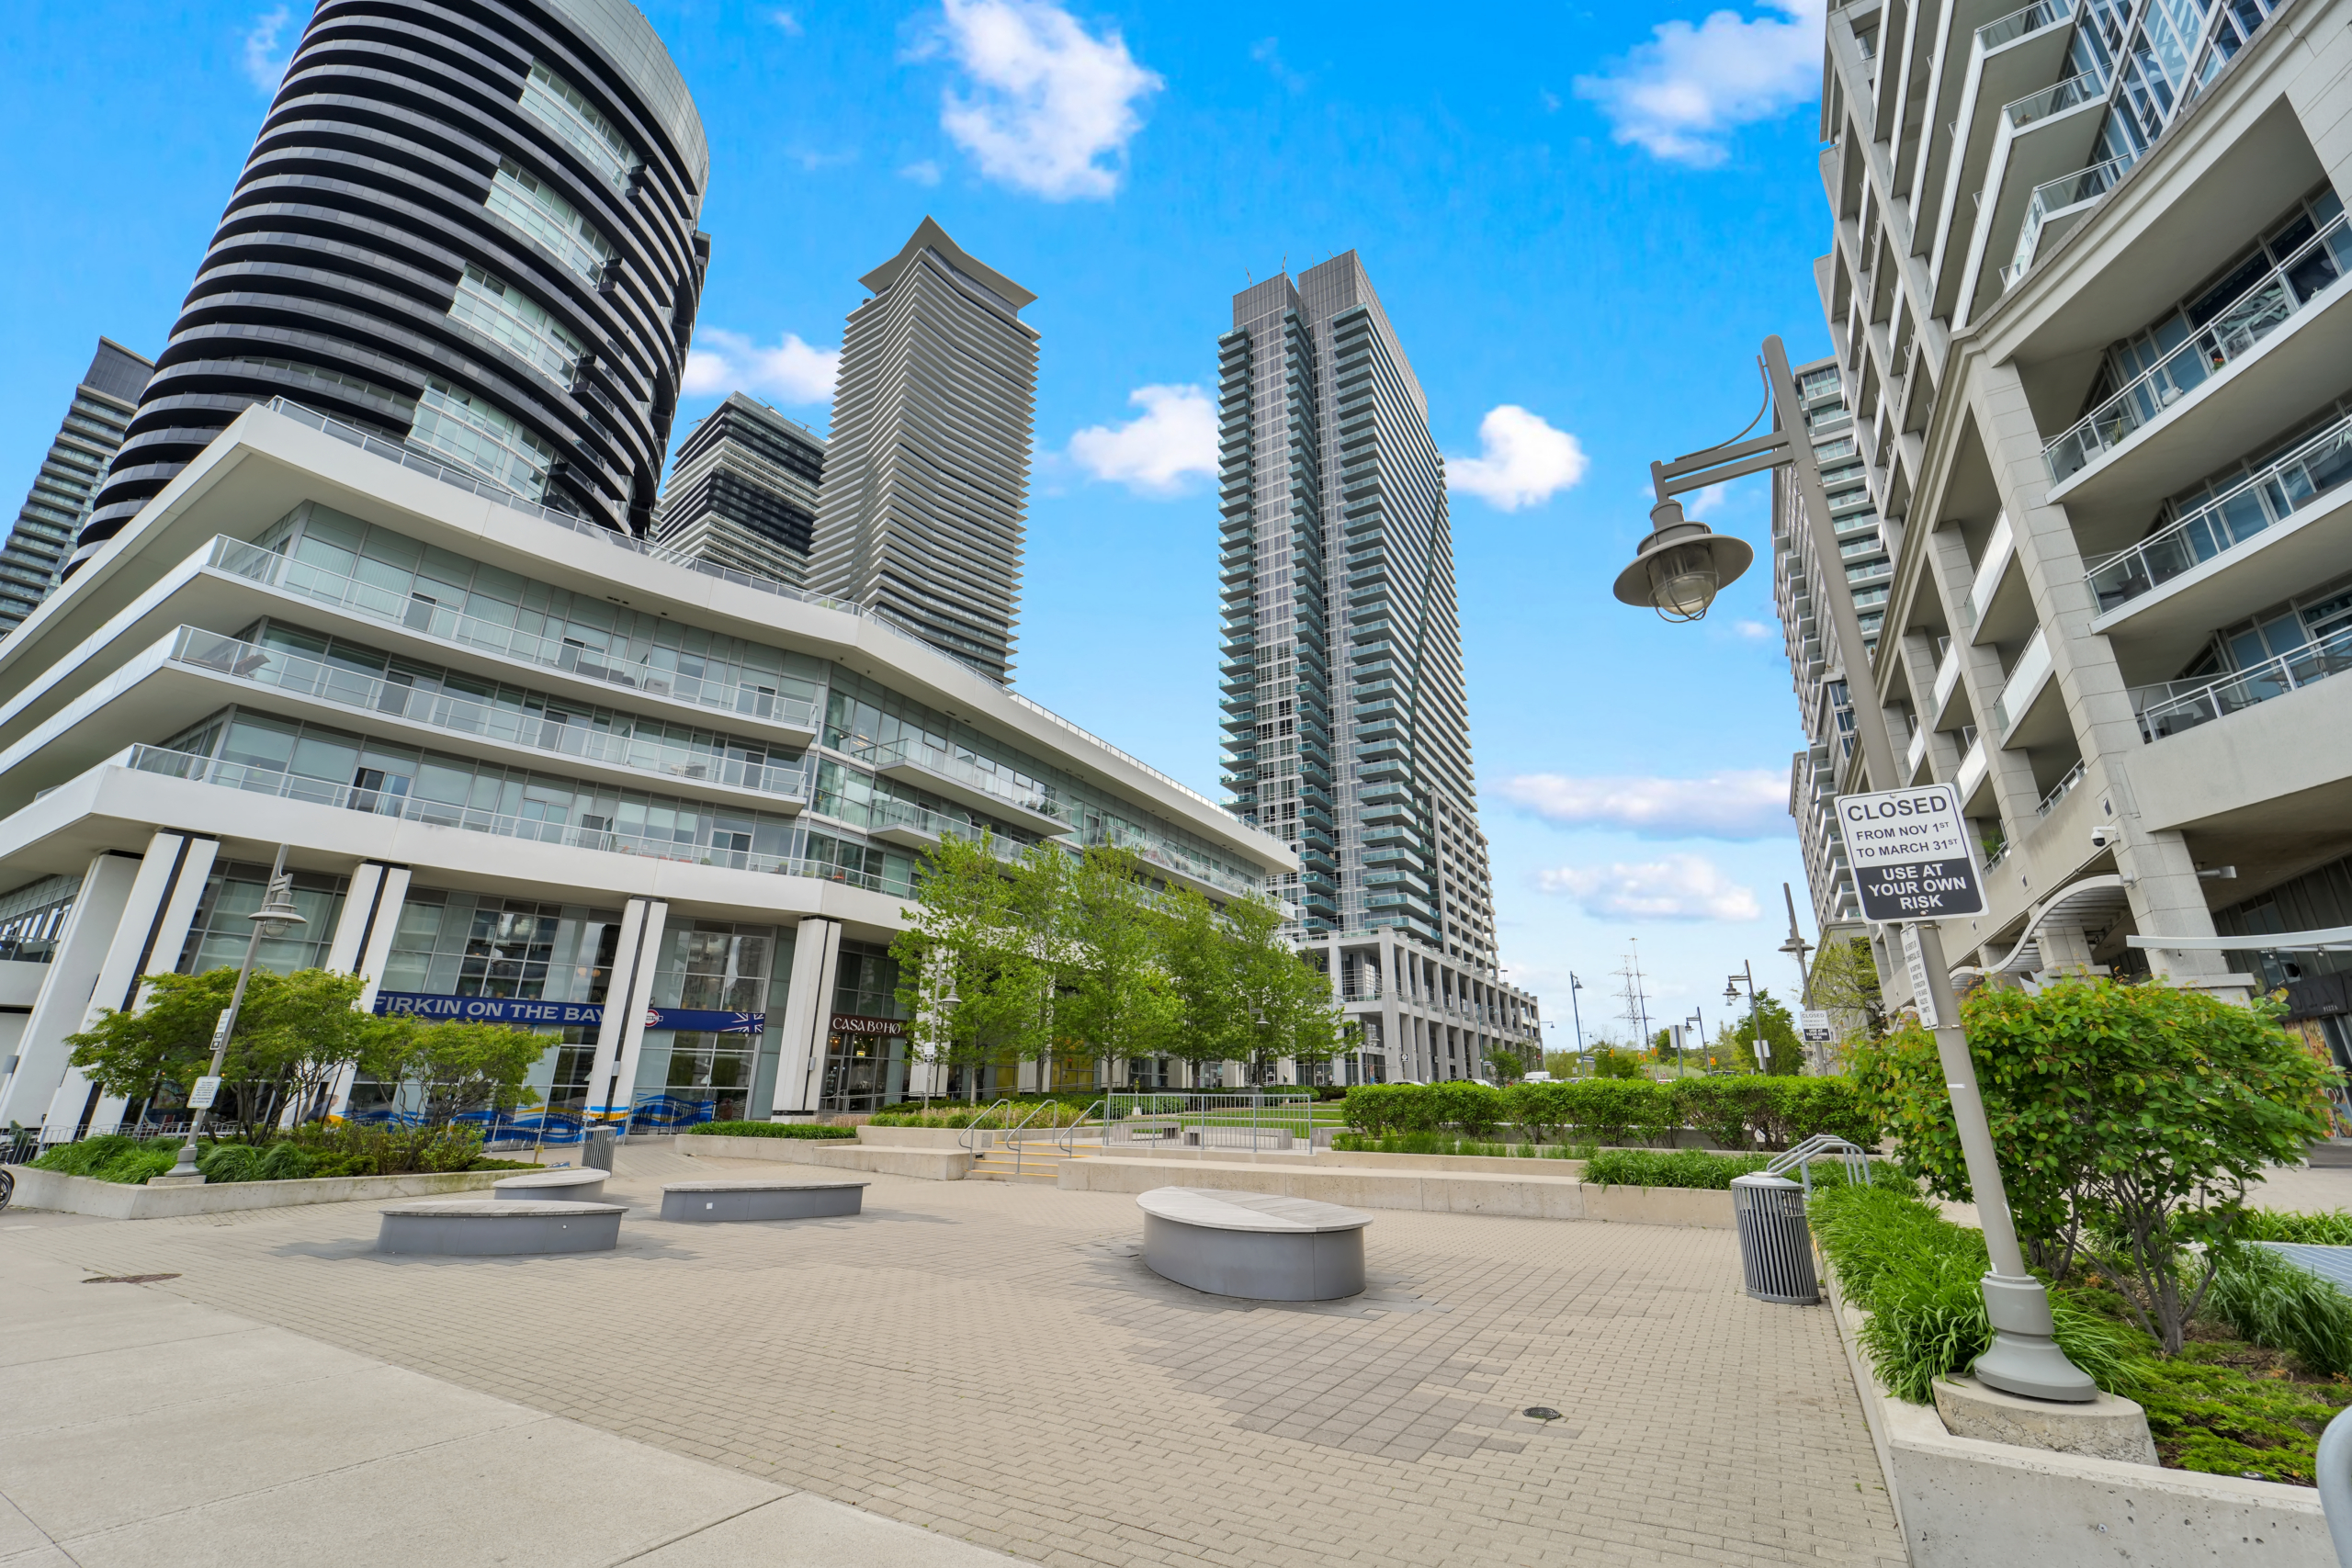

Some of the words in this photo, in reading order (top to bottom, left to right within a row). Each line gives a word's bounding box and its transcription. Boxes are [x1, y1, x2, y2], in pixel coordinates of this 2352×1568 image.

[1847, 795, 1947, 821] CLOSED
[1856, 828, 1895, 841] FROM
[1899, 824, 1928, 836] NOV
[1933, 822, 1950, 833] 1ST
[1856, 847, 1875, 858] TO
[1878, 842, 1929, 856] MARCH
[1933, 838, 1958, 850] 31ST
[1882, 866, 1918, 881] USE
[1923, 863, 1943, 878] AT
[1868, 881, 1920, 897] YOUR
[1923, 876, 1967, 893] OWN
[1900, 894, 1943, 910] RISK
[467, 1001, 504, 1017] ON
[510, 1004, 559, 1020] THE
[2323, 1004, 2339, 1013] PIZZA
[832, 1017, 865, 1032] CASA
